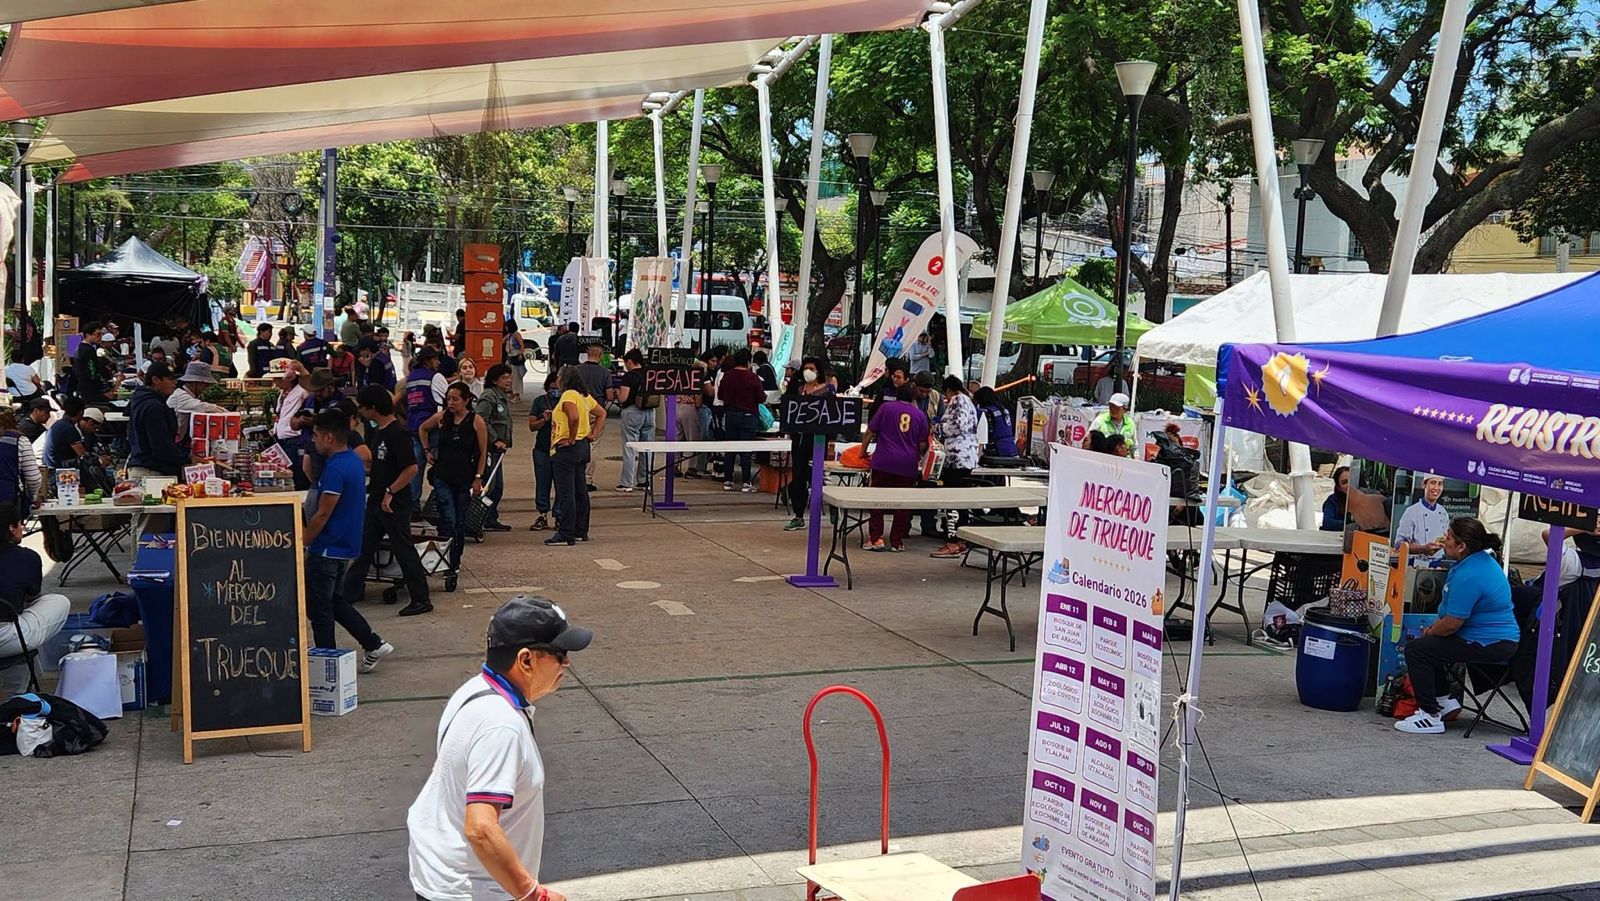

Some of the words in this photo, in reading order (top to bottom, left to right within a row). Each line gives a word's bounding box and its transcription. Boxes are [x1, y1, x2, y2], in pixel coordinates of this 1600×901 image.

[931, 261, 941, 271] 2
[646, 370, 700, 391] PESAJE
[787, 400, 855, 425] PESAJE
[900, 413, 911, 432] 8
[1080, 480, 1152, 524] MERCADO
[947, 510, 960, 539] Pink
[190, 522, 292, 556] BIENVENIDOS
[1067, 511, 1089, 540] DE
[1091, 516, 1156, 560] TRUEQUE
[229, 559, 251, 581] AL
[216, 581, 275, 604] MERCADO
[1072, 571, 1121, 599] Calendario
[1124, 588, 1147, 608] 2026
[231, 605, 266, 626] DEL
[1060, 602, 1072, 612] ENE
[1073, 604, 1079, 613] 11
[1103, 617, 1112, 626] FEB
[196, 637, 299, 682] TRUEQUE
[1055, 661, 1068, 671] ABR
[1068, 665, 1076, 674] 12
[1097, 676, 1110, 688] MAY
[1111, 681, 1118, 691] 10
[1050, 721, 1062, 731] JUL
[1063, 723, 1071, 734] 12
[1095, 738, 1107, 750] AGO
[1136, 757, 1146, 767] SEP
[1147, 762, 1153, 772] 13
[1044, 780, 1057, 790] OCT
[1058, 784, 1066, 793] 11
[1043, 795, 1064, 808] PARQUE
[1089, 799, 1102, 809] NOV
[1133, 821, 1143, 831] DIC
[1061, 846, 1083, 863] EVENTO
[1085, 857, 1114, 878] GRATUITO
